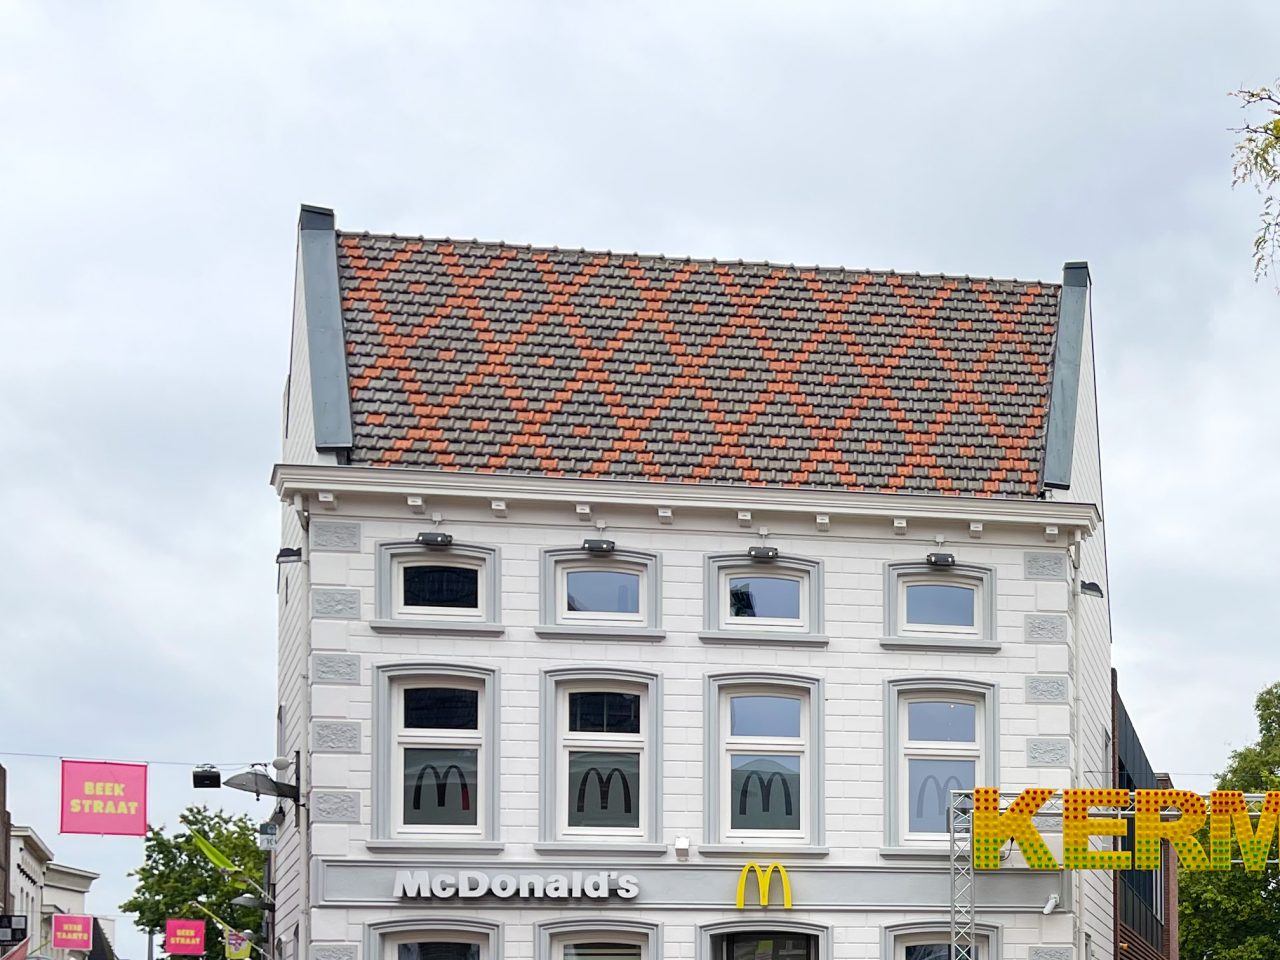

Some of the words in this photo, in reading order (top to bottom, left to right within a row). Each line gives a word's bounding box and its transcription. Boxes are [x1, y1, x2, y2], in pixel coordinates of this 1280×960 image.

[83, 781, 126, 797] BEEK
[70, 799, 138, 815] STRAAT
[392, 870, 641, 899] McDonald's
